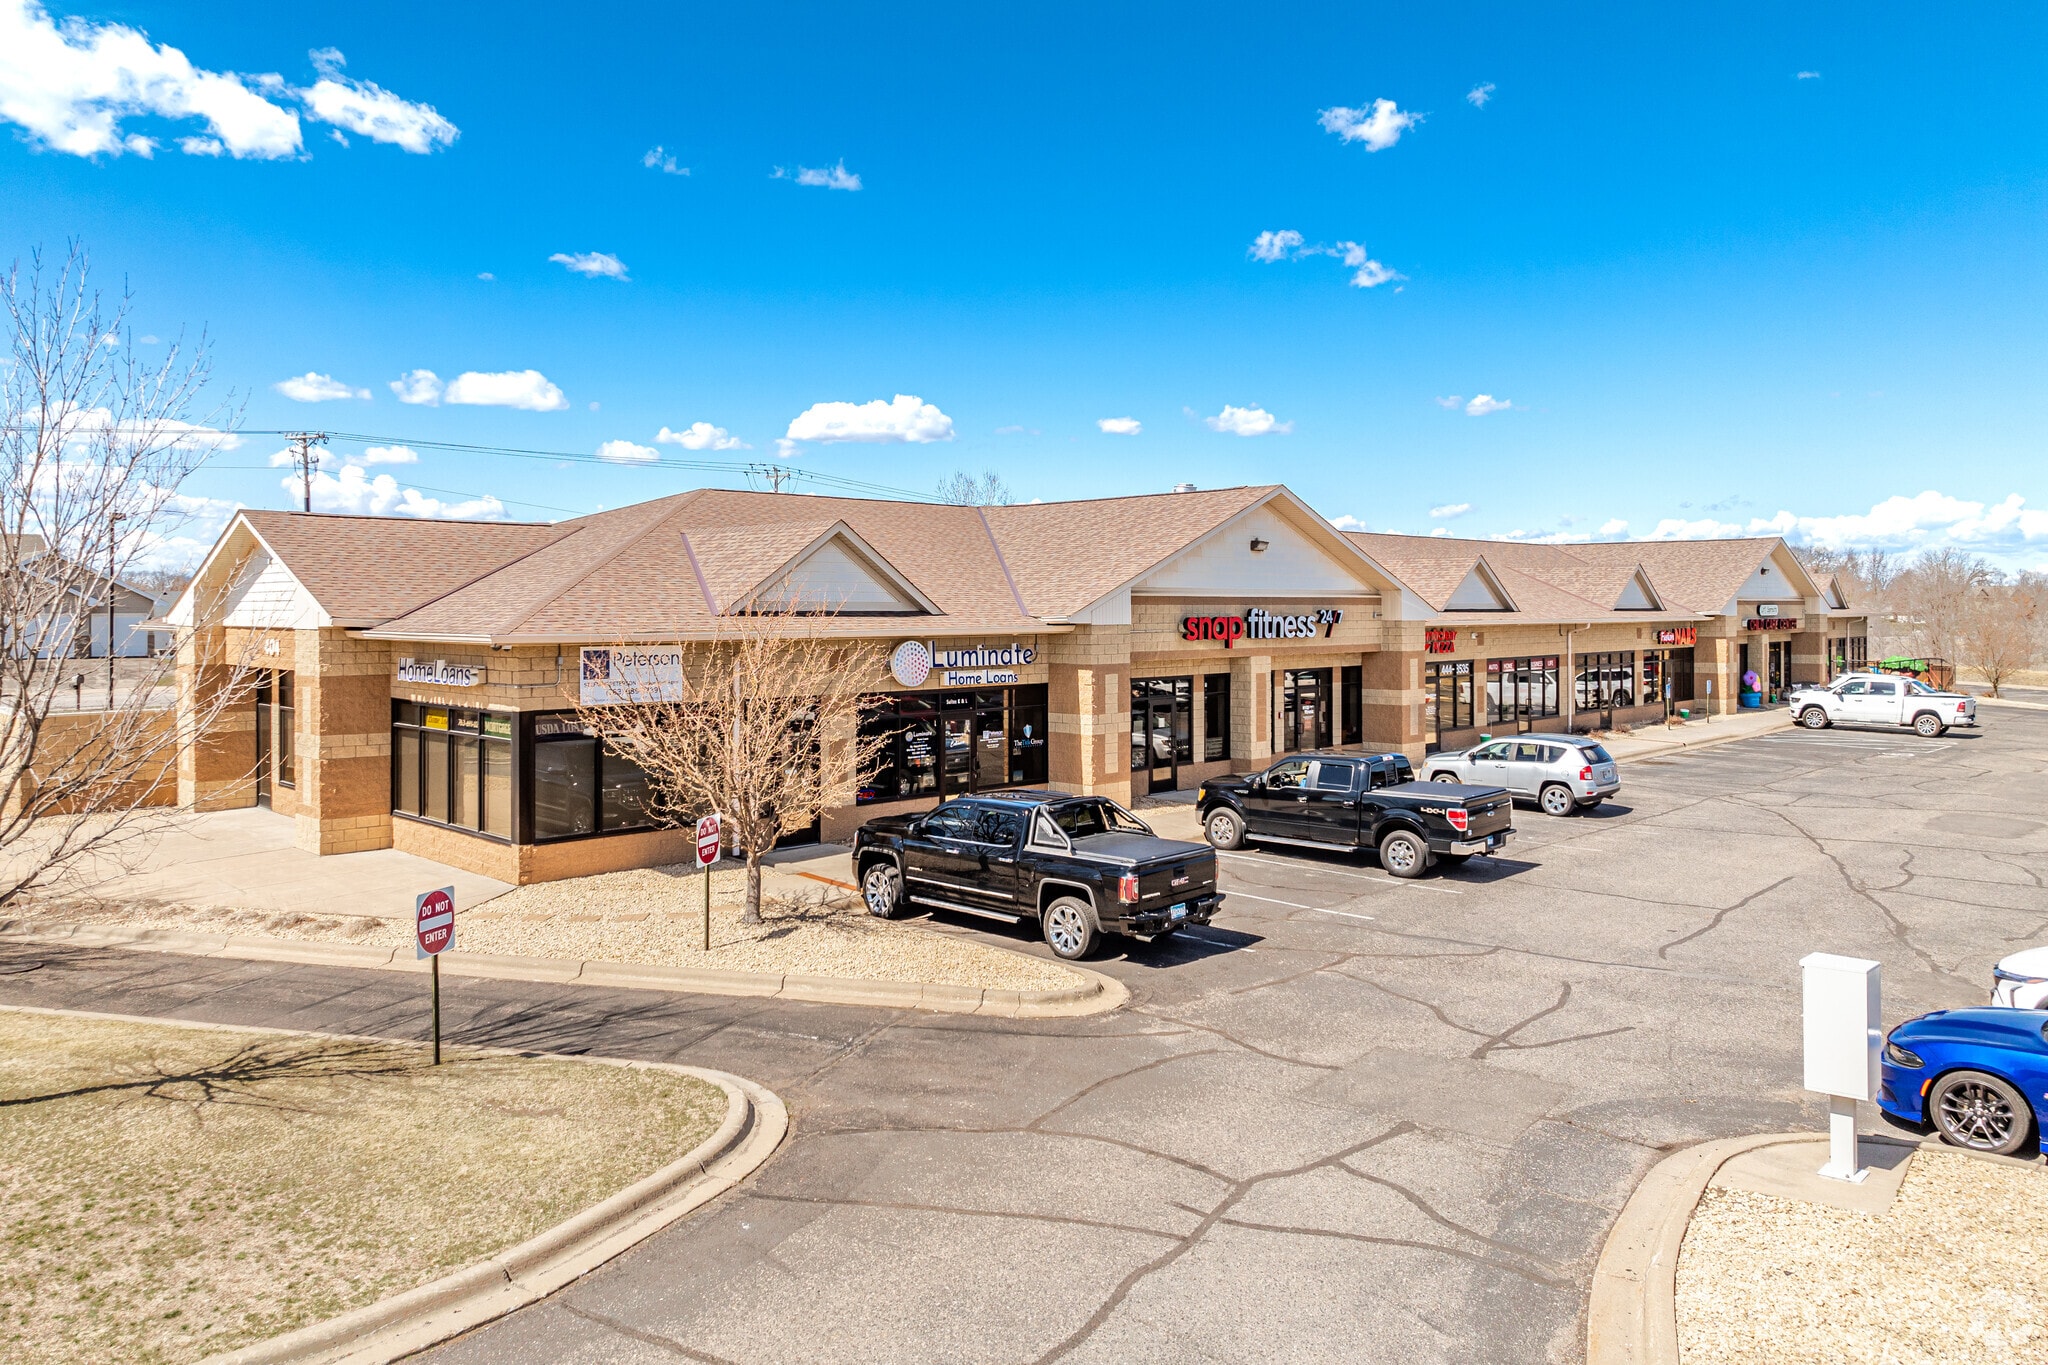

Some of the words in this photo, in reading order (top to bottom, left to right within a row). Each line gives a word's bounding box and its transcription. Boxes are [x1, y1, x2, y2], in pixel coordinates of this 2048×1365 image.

[1187, 616, 1244, 649] snap
[1248, 608, 1317, 639] fitness
[1674, 628, 1697, 644] NAILS
[613, 652, 680, 667] Peterson
[932, 640, 1034, 668] Luminate
[949, 672, 982, 685] Home
[986, 669, 1019, 684] Loans
[535, 724, 560, 736] USDA
[422, 905, 431, 917] DO
[435, 899, 450, 912] NOT
[425, 928, 447, 945] ENTER
